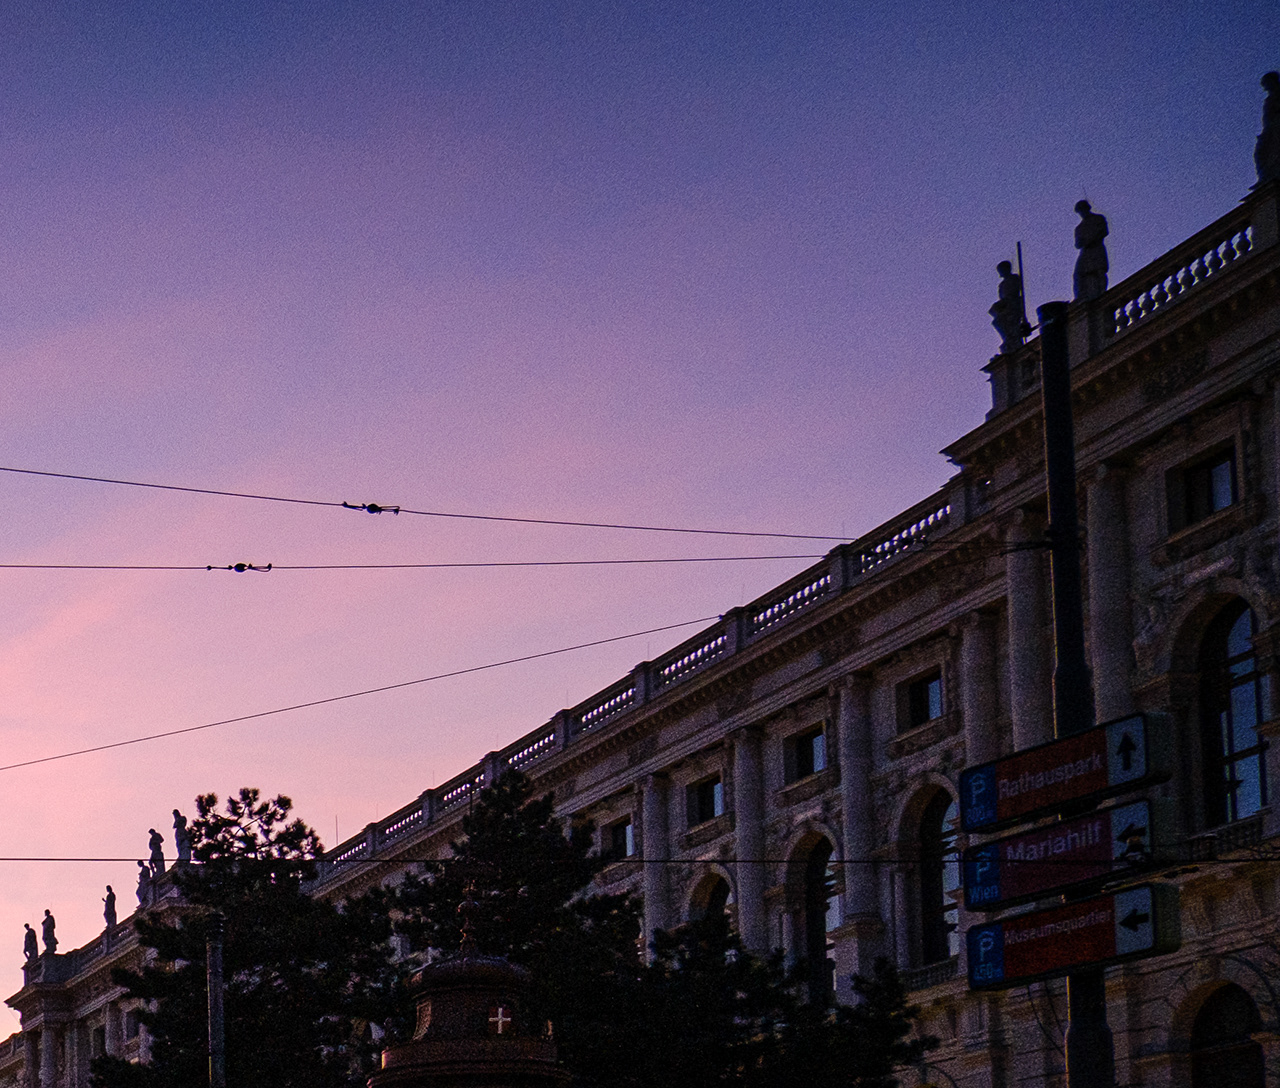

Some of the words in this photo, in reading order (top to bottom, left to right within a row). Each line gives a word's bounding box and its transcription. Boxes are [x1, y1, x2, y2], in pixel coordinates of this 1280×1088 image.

[998, 752, 1104, 801] Rathauspark
[1006, 821, 1103, 867] Mariahilf
[968, 885, 1000, 904] Wien
[1004, 908, 1112, 945] Museumsquartier
